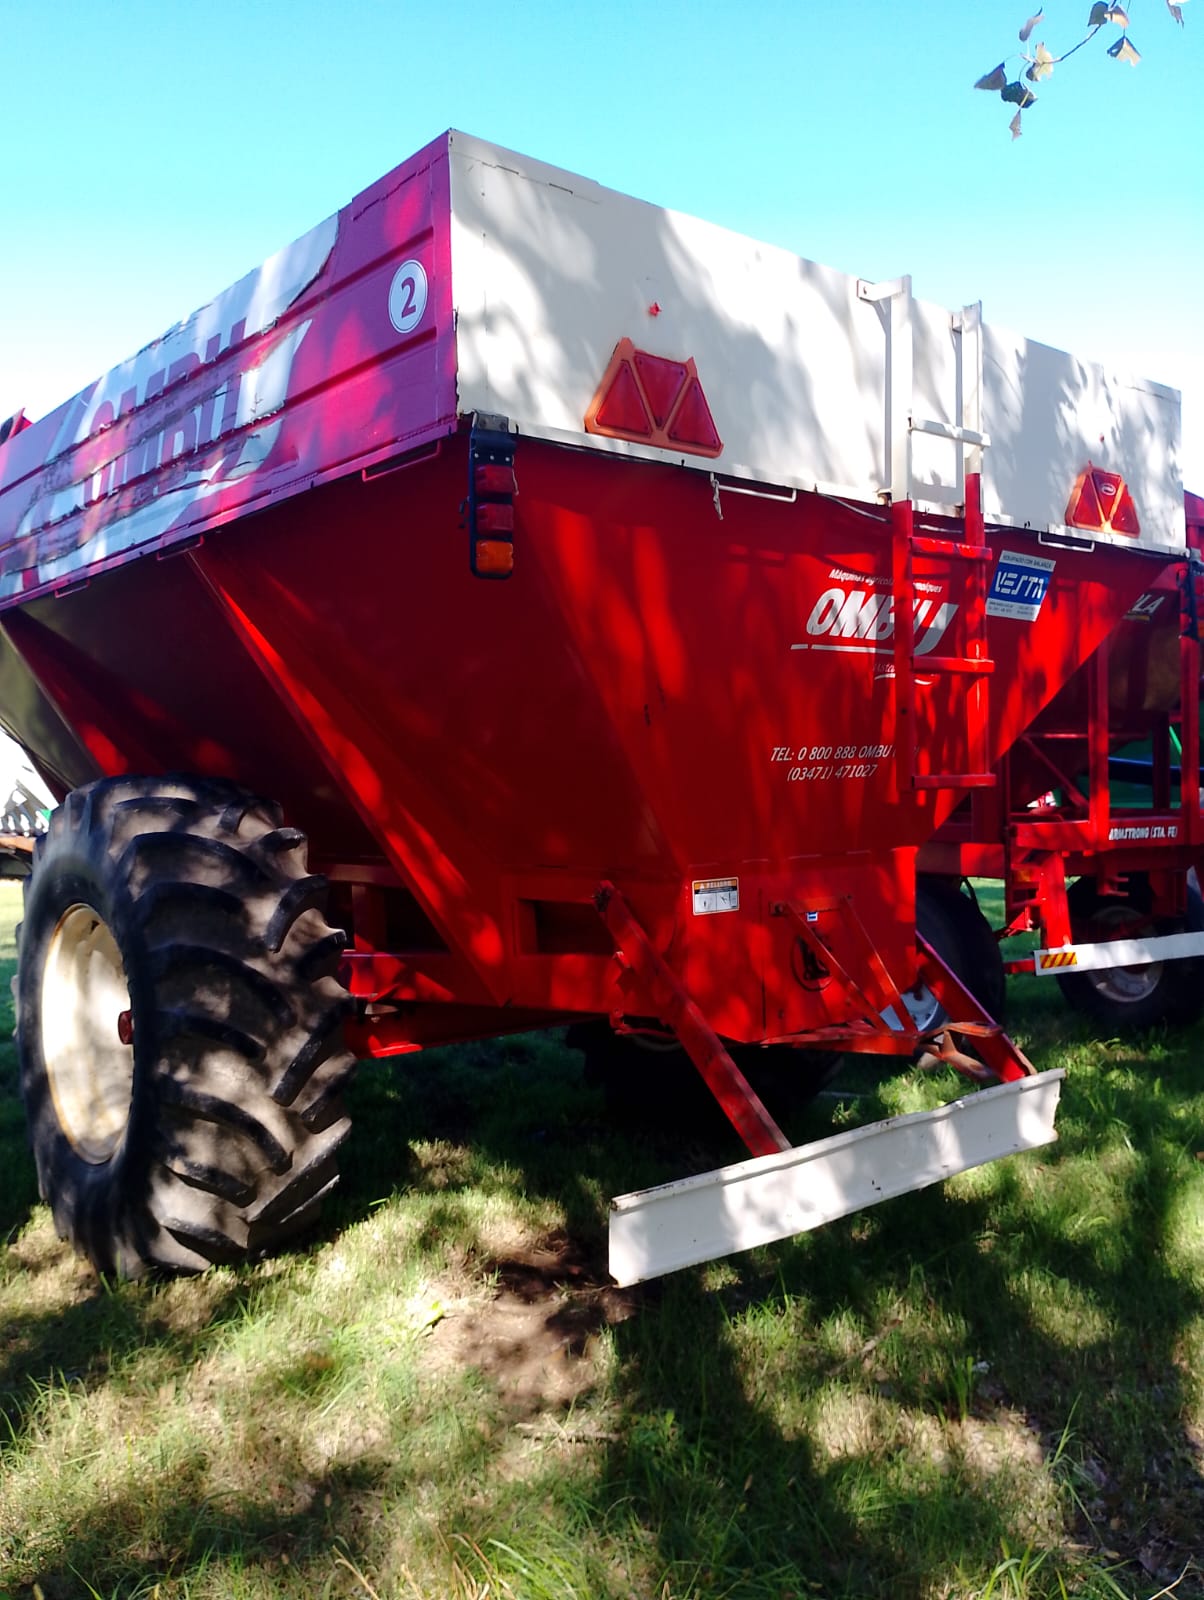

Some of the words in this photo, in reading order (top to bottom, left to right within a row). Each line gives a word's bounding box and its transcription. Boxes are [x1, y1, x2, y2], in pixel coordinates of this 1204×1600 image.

[401, 276, 418, 319] 2
[806, 588, 960, 656] OMBU
[770, 747, 795, 761] TEL:
[797, 746, 808, 761] 0
[808, 746, 833, 760] 800
[833, 745, 857, 760] 888
[858, 744, 893, 758] OMBU
[787, 766, 834, 782] (03471)
[834, 764, 879, 779] 471027
